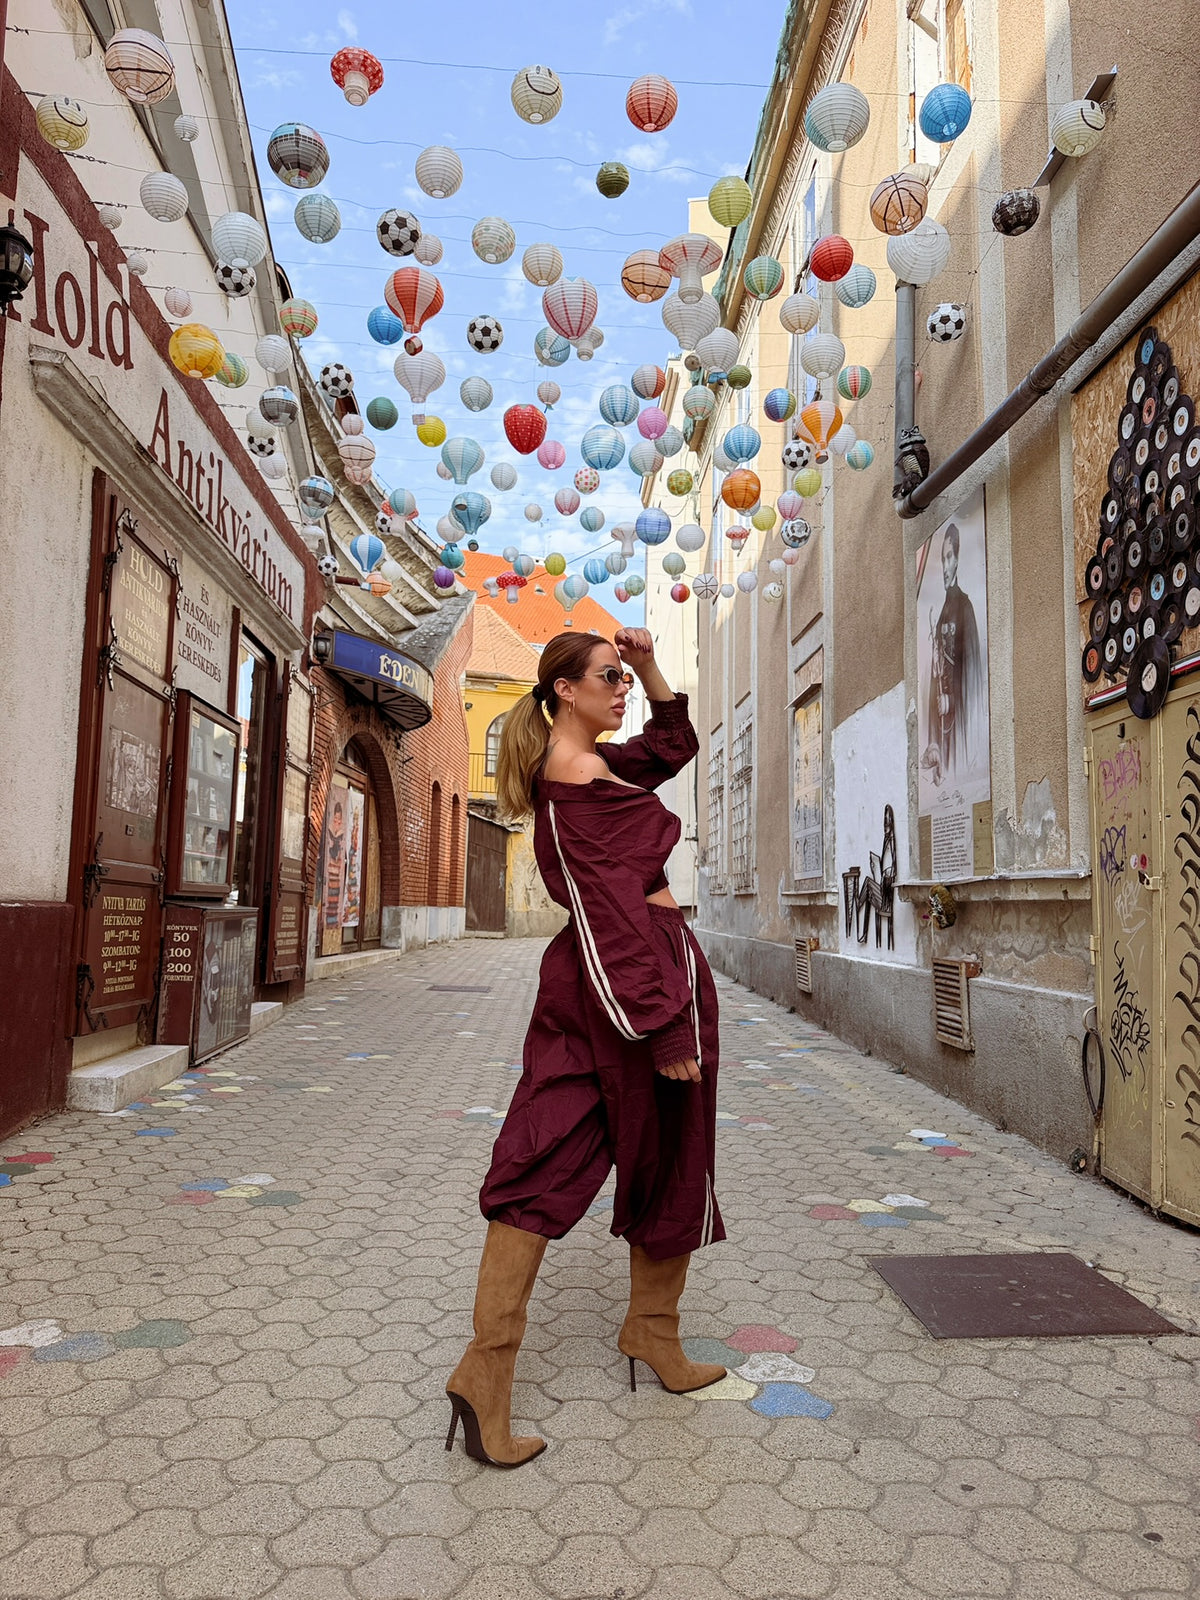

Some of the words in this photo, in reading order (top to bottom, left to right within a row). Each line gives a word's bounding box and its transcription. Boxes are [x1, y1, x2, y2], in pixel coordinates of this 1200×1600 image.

[147, 388, 293, 621] Antikvárium
[130, 546, 163, 593] HOLD
[201, 583, 209, 606] ÉS
[173, 932, 190, 942] 50
[169, 947, 191, 957] 100
[167, 962, 191, 973] 200
